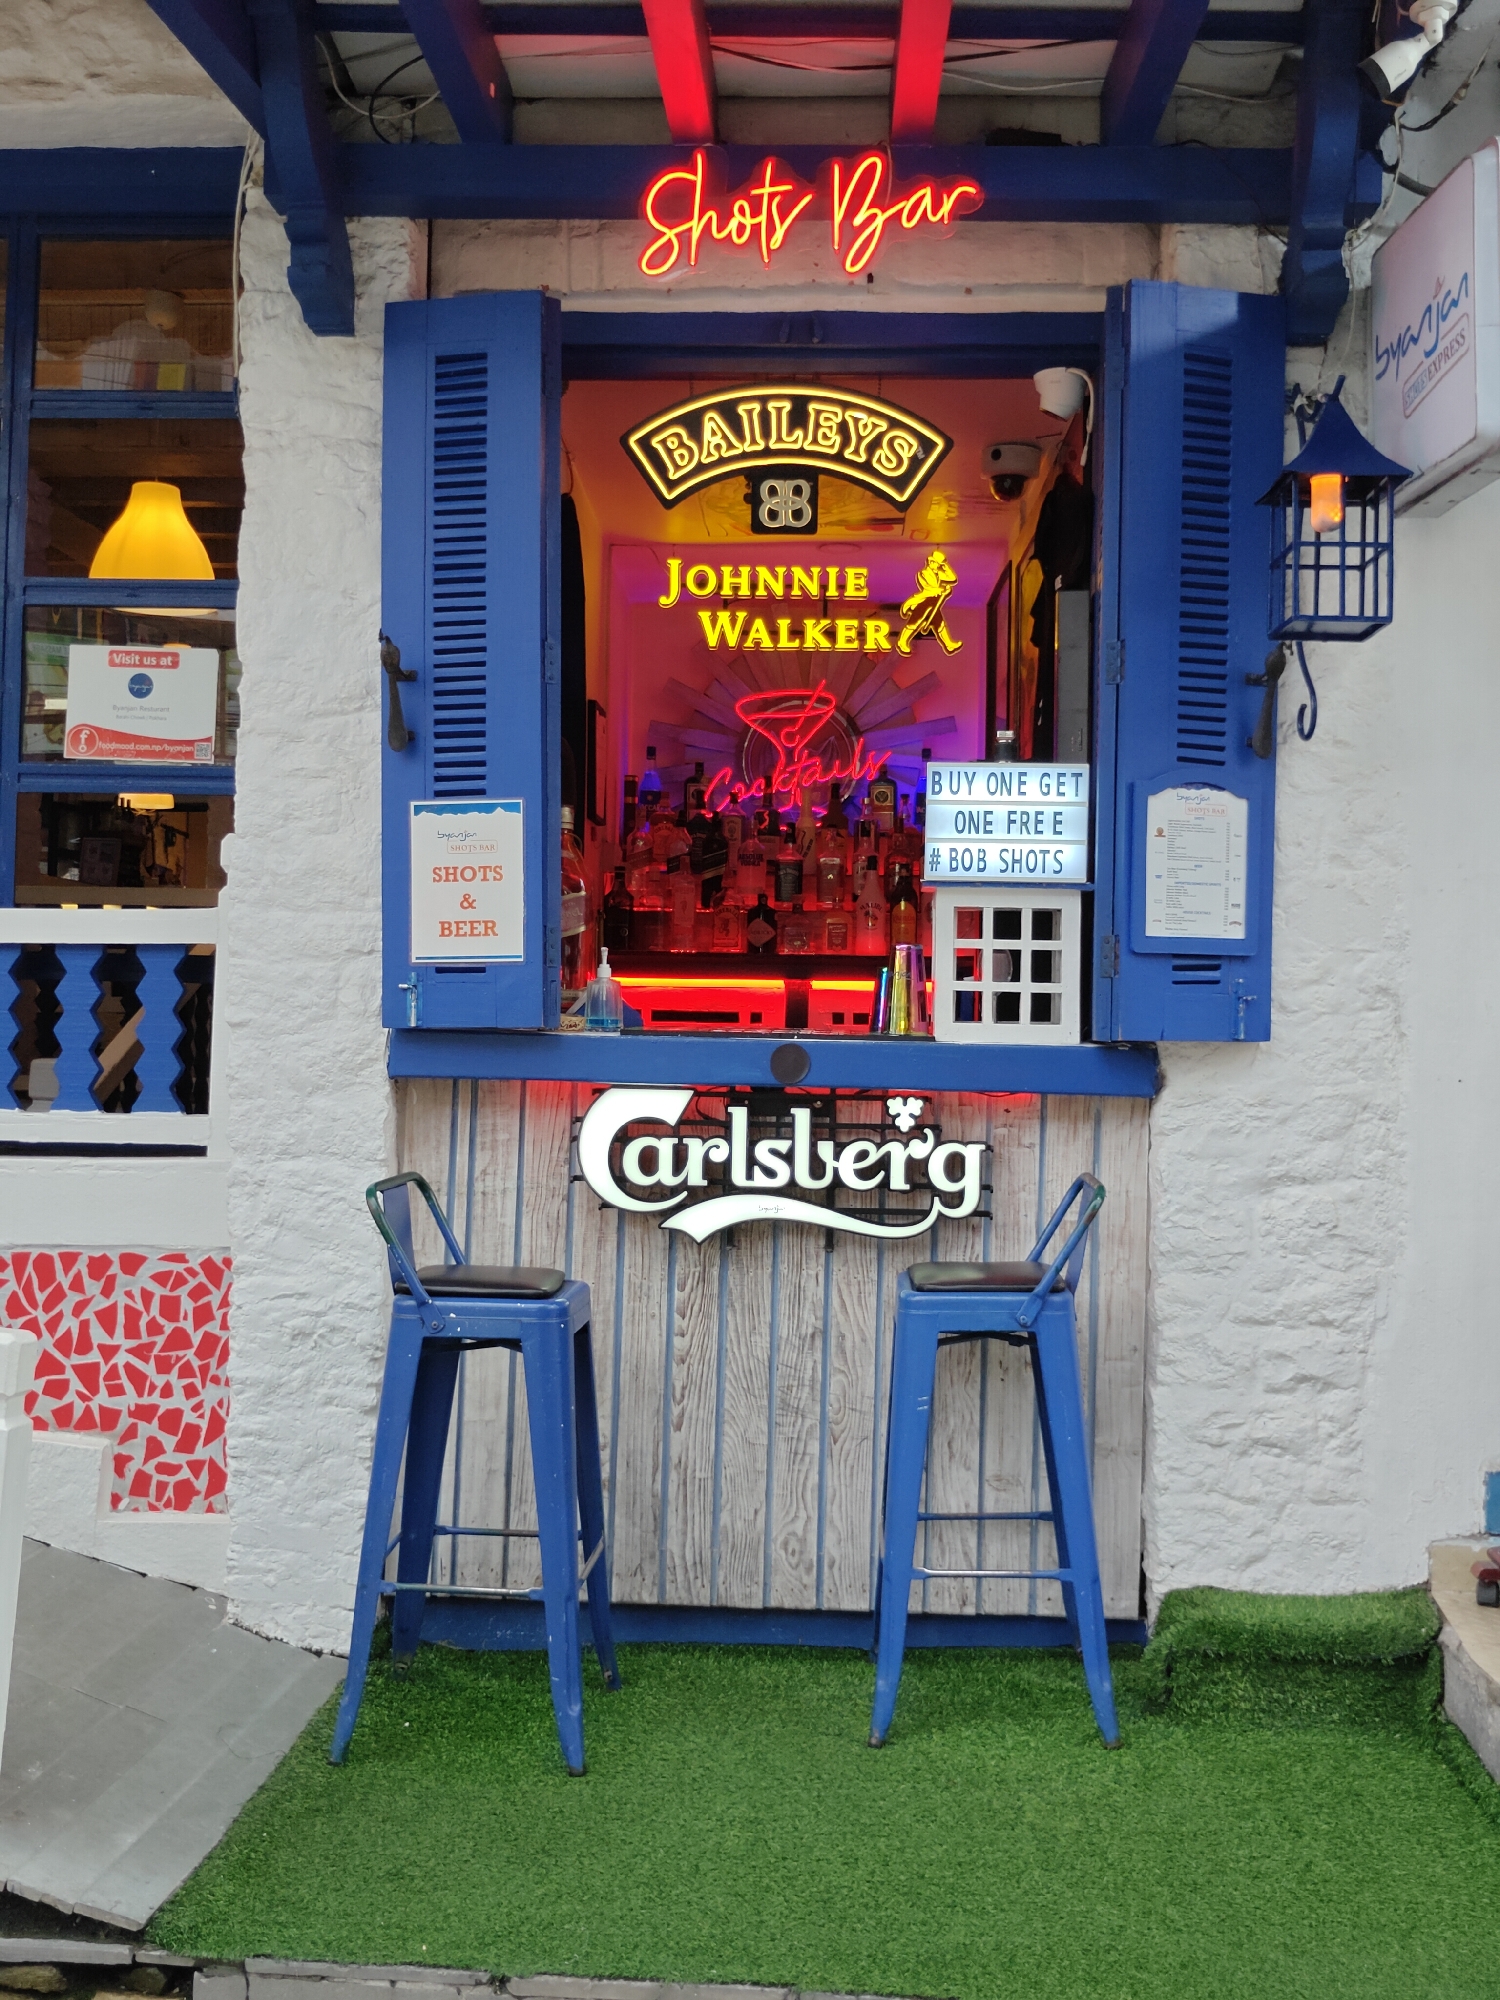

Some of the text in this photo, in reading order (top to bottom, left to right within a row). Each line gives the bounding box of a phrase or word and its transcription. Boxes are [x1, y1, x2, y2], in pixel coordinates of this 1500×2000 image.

[639, 151, 977, 276] Shots Bar
[1375, 272, 1469, 382] byanjan
[1427, 328, 1466, 382] EXPRESS
[652, 400, 917, 480] BAILEYS
[659, 558, 868, 608] JOHNNIE
[698, 610, 892, 652] WALKER
[113, 653, 172, 666] Visit us at
[931, 771, 1083, 798] BUY ONE GET
[954, 810, 1063, 836] ONE FREE
[1187, 807, 1210, 815] SHOTS
[437, 830, 477, 842] byanjan
[450, 844, 496, 853] SHOTS BAR
[432, 864, 504, 883] SHOTS
[999, 848, 1064, 875] SHOTS
[459, 893, 477, 910] &
[438, 919, 499, 938] BEER
[577, 1088, 986, 1221] Carlsberg
